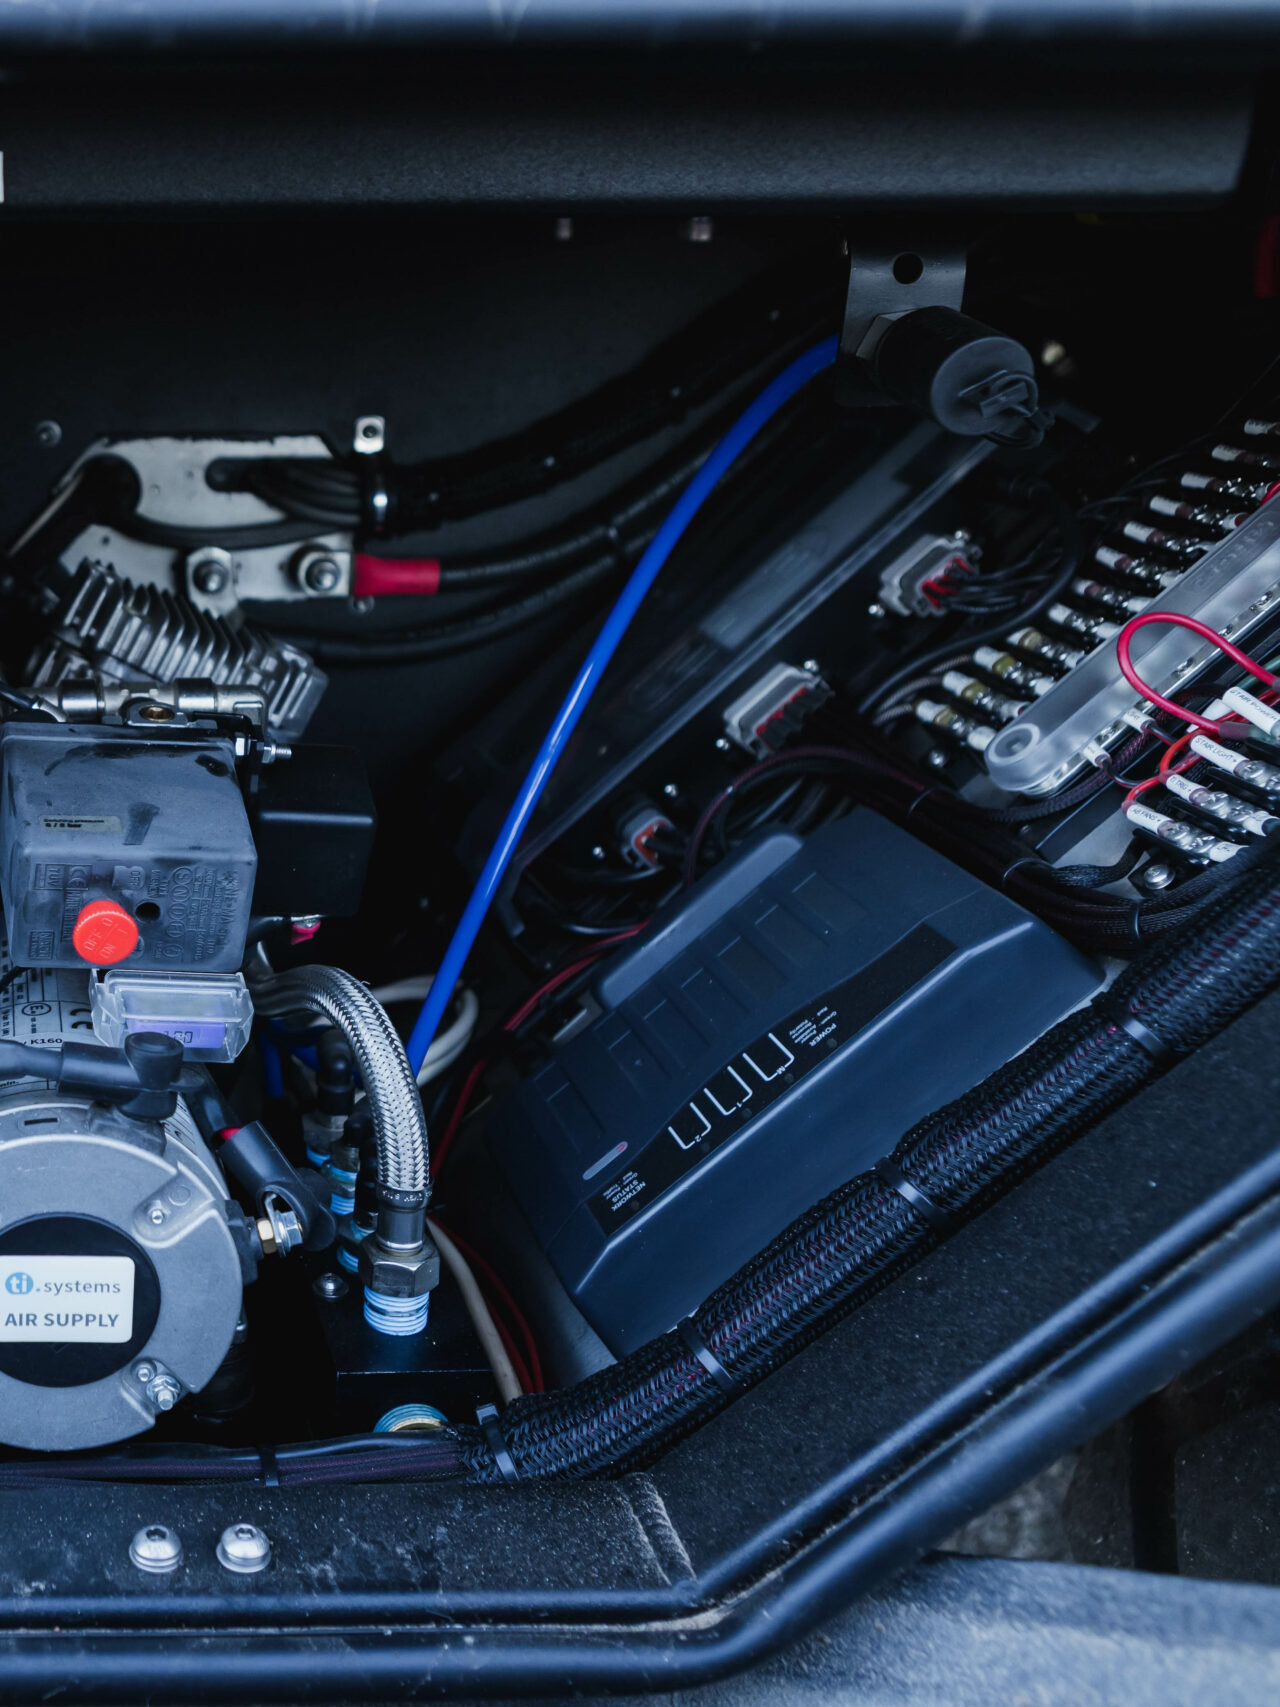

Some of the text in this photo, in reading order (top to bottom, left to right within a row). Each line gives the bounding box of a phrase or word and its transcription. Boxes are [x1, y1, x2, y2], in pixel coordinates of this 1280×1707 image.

[30, 1037, 64, 1046] K160
[809, 1023, 837, 1047] POWER
[611, 1181, 646, 1212] NETWORK
[612, 1180, 639, 1203] STATUS
[4, 1312, 121, 1328] AIR SUPPLY
